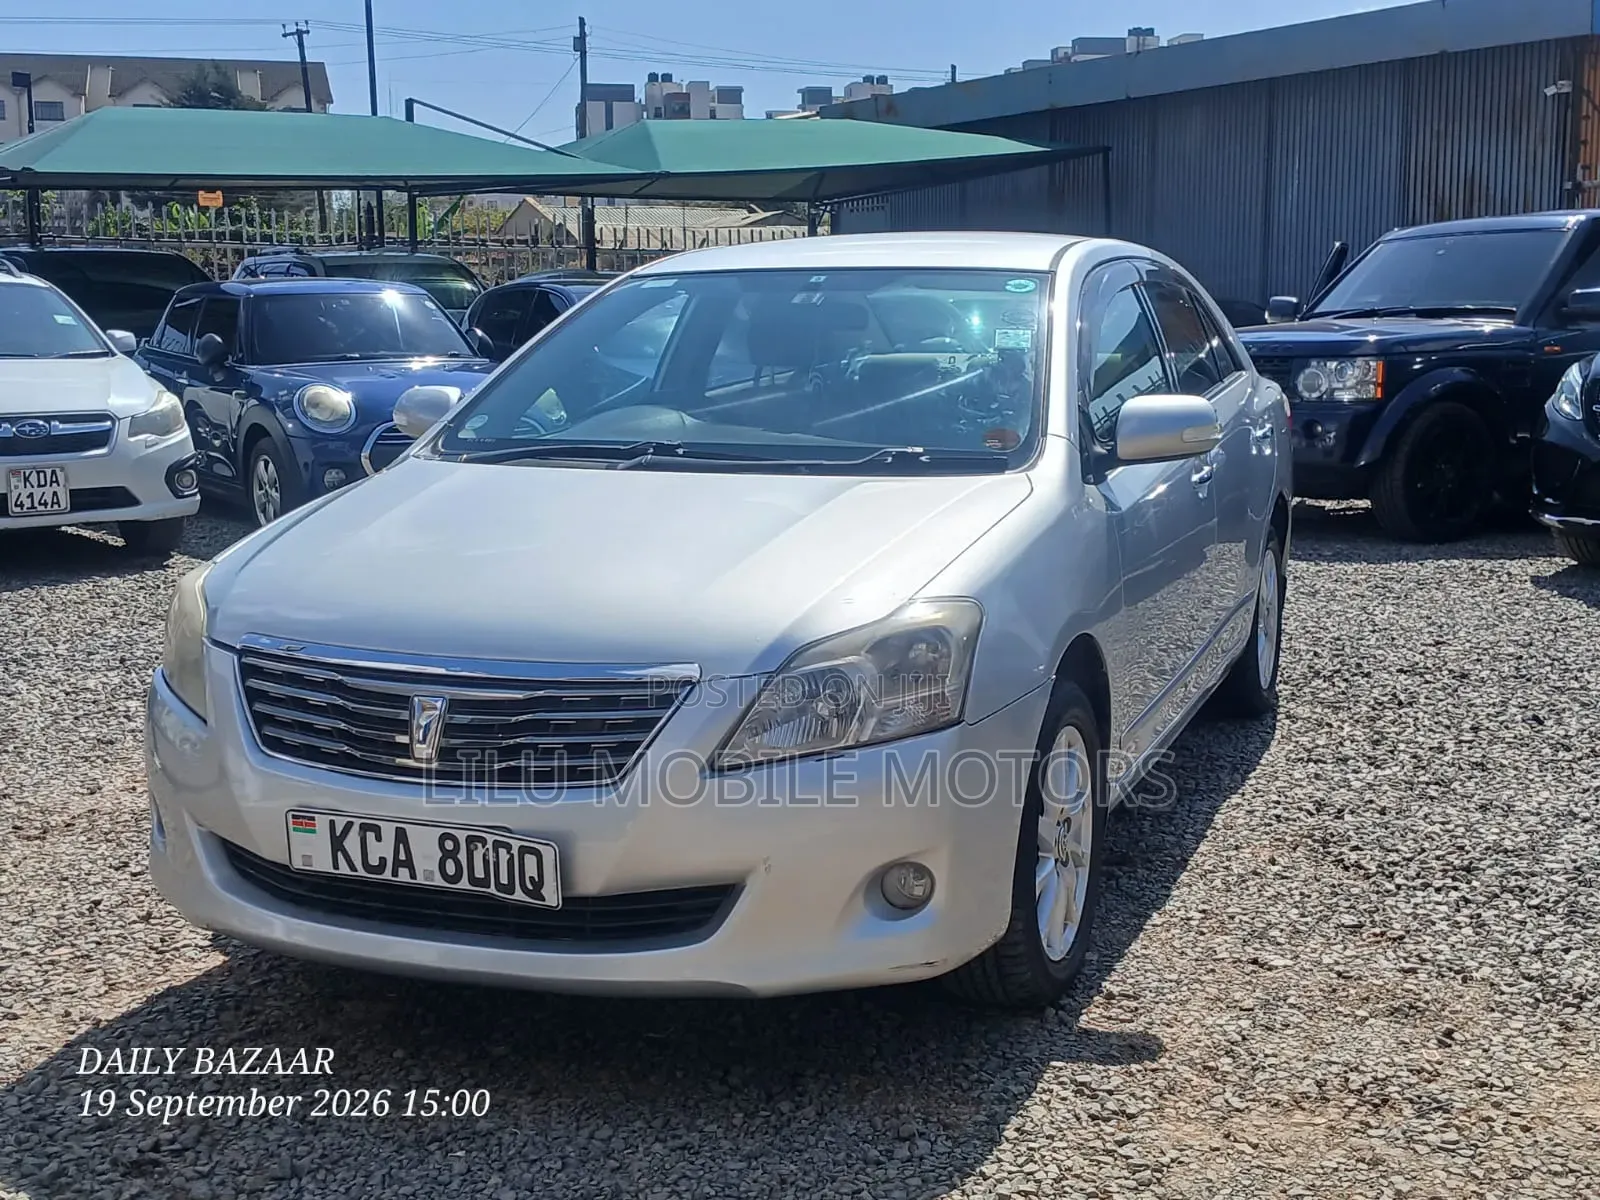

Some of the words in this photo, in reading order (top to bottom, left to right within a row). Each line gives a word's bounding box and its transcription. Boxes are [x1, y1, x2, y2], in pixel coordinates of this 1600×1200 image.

[23, 469, 60, 489] KDA
[14, 490, 61, 511] 414A
[328, 818, 418, 881] KCA
